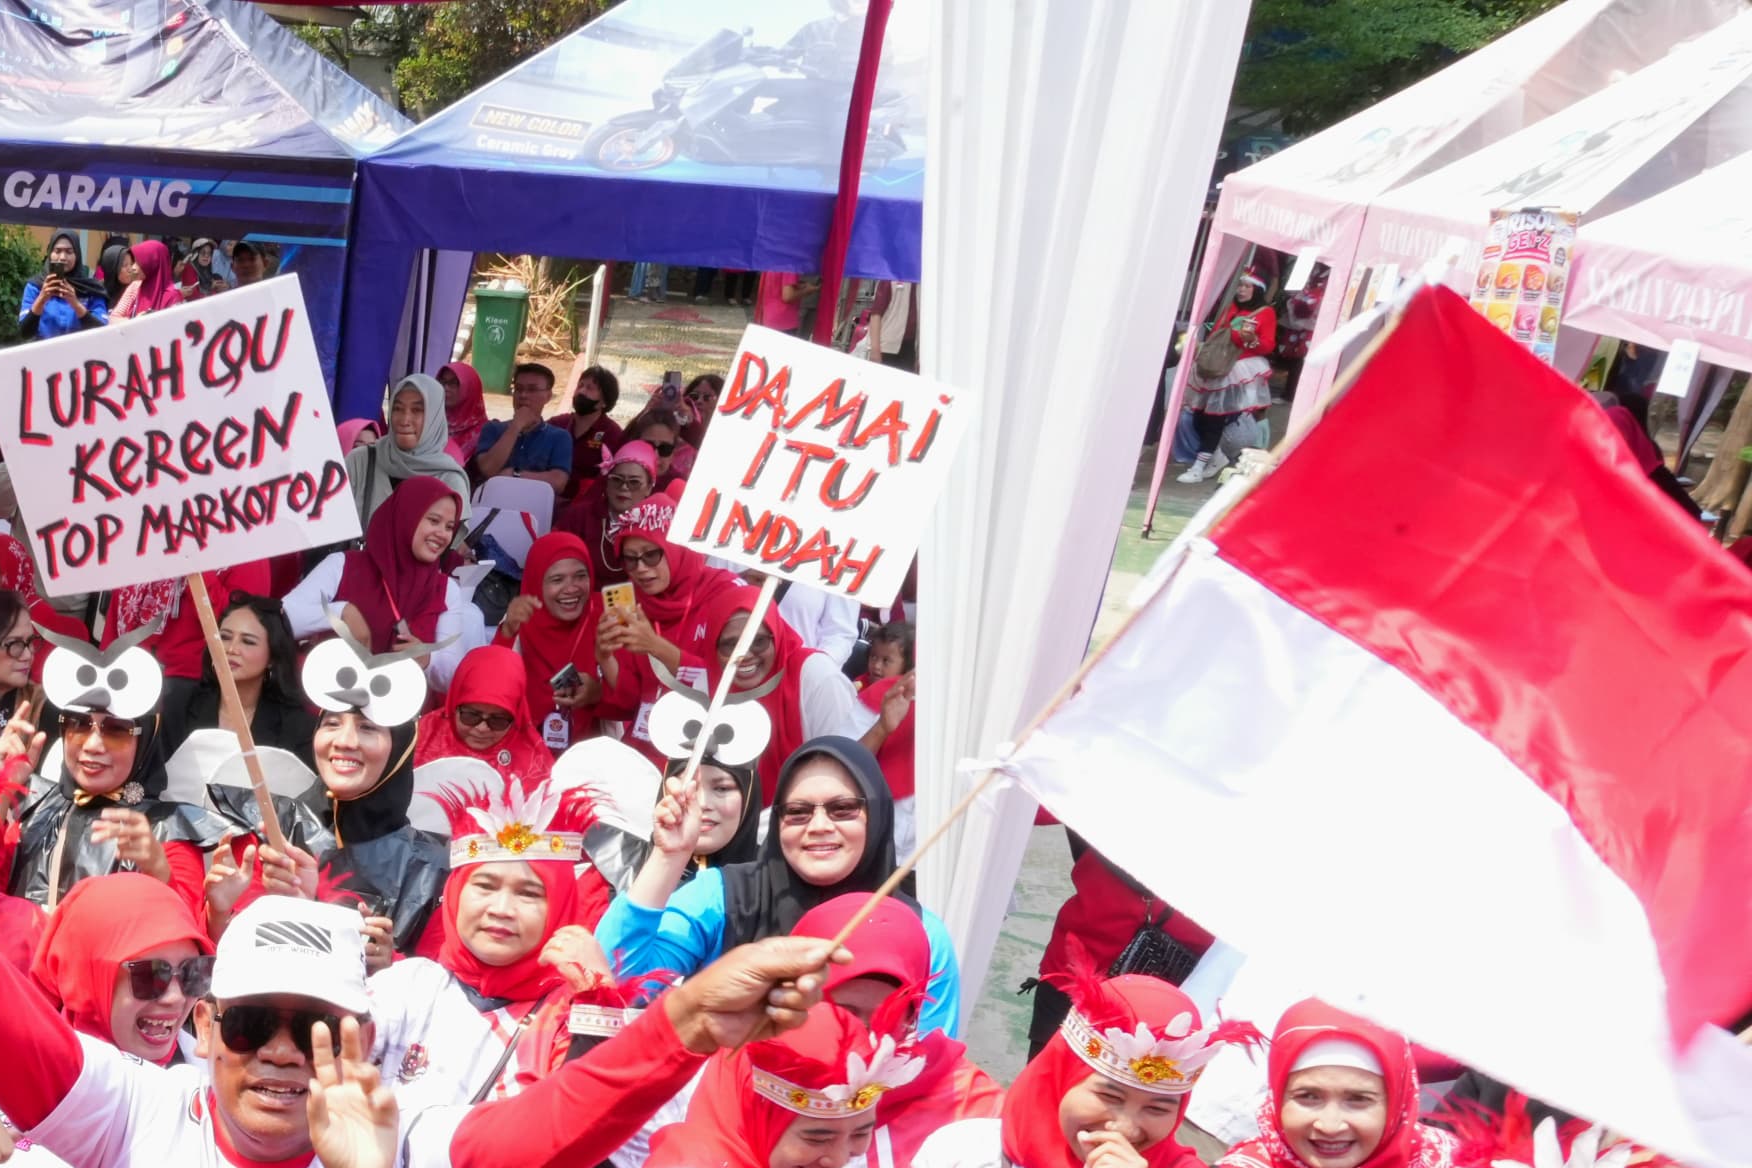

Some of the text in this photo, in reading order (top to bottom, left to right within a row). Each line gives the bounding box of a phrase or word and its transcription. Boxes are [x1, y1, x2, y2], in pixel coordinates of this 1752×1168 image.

[476, 134, 540, 157] Ceramic
[484, 110, 582, 138] NEW COLOR
[3, 171, 193, 218] GARANG
[741, 431, 881, 511] ITU
[36, 460, 348, 580] TOP MARKOTOP
[689, 488, 885, 594] INDAH
